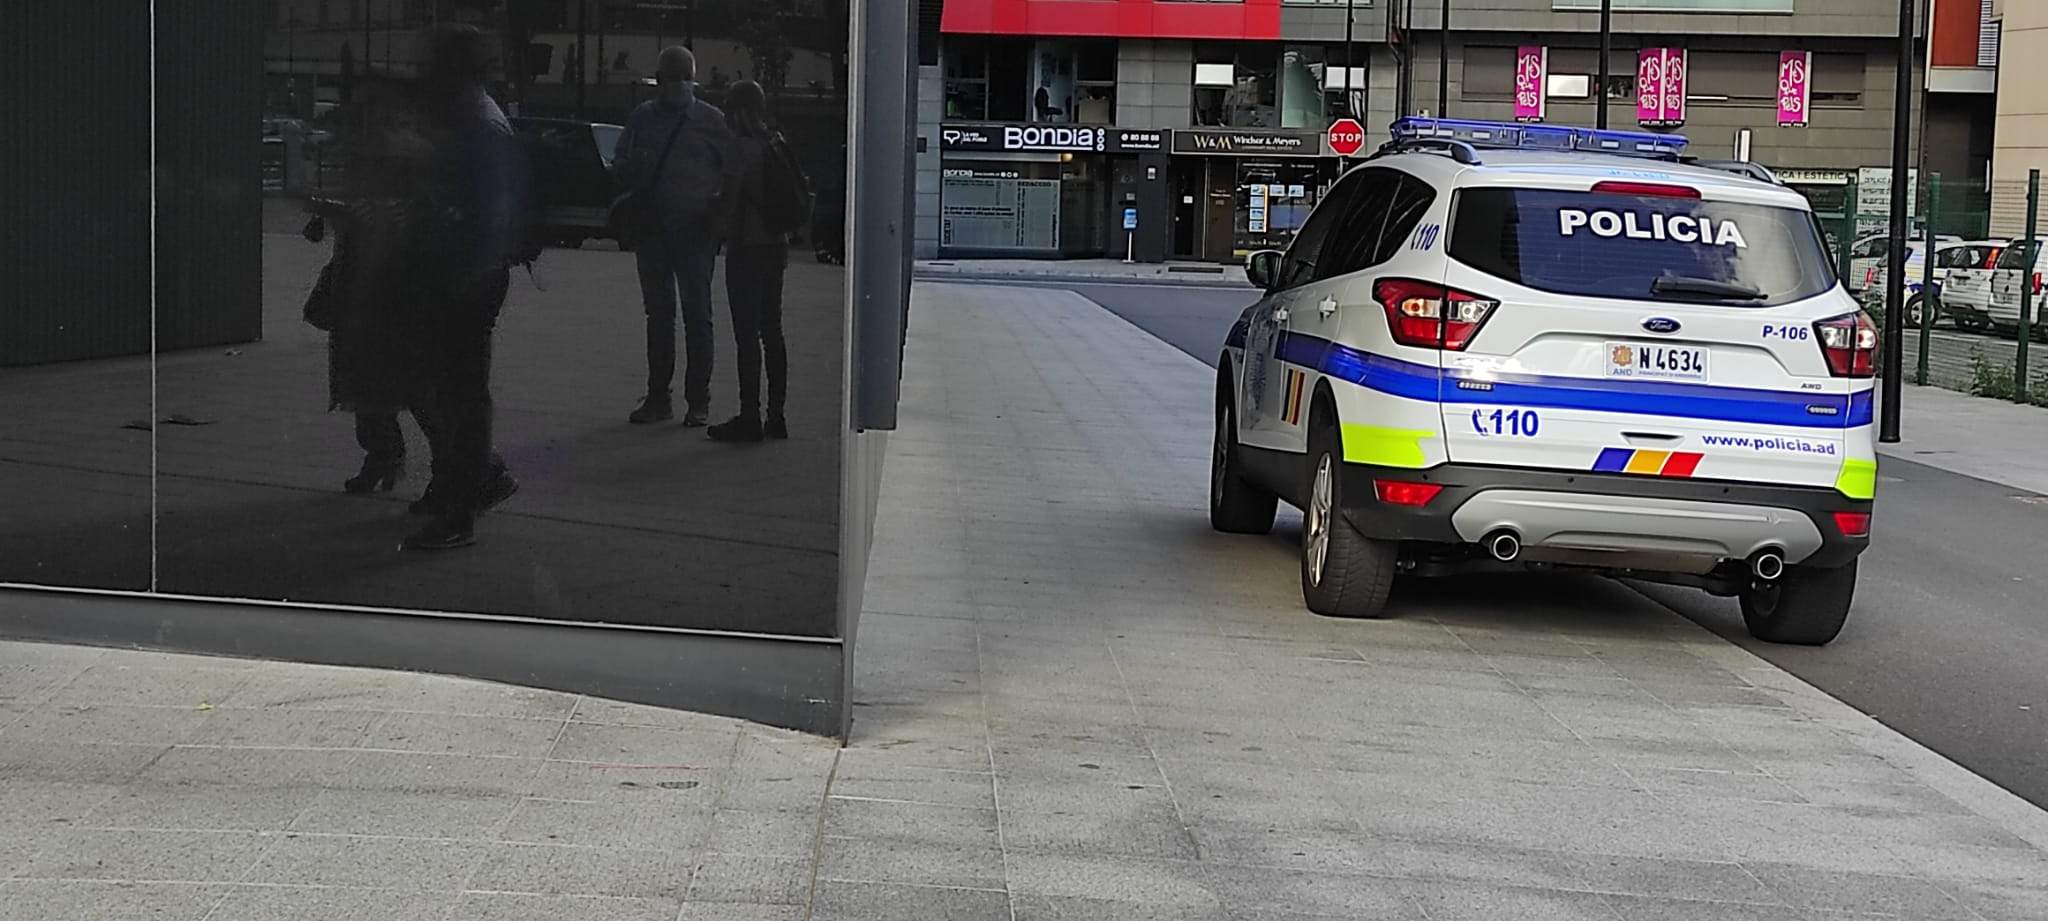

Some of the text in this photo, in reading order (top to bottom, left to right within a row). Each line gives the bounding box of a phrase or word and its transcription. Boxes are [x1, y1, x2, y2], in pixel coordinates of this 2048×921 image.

[1331, 133, 1362, 143] STOP
[1775, 170, 1795, 179] TICA
[1415, 223, 1440, 251] 110
[1559, 209, 1748, 249] POLICIA
[1650, 320, 1673, 330] Ford
[1762, 325, 1808, 340] P-106
[1640, 347, 1703, 374] N 4634
[1612, 368, 1633, 376] AND
[1490, 409, 1539, 437] 110
[1702, 435, 1836, 455] www.policia.ad
